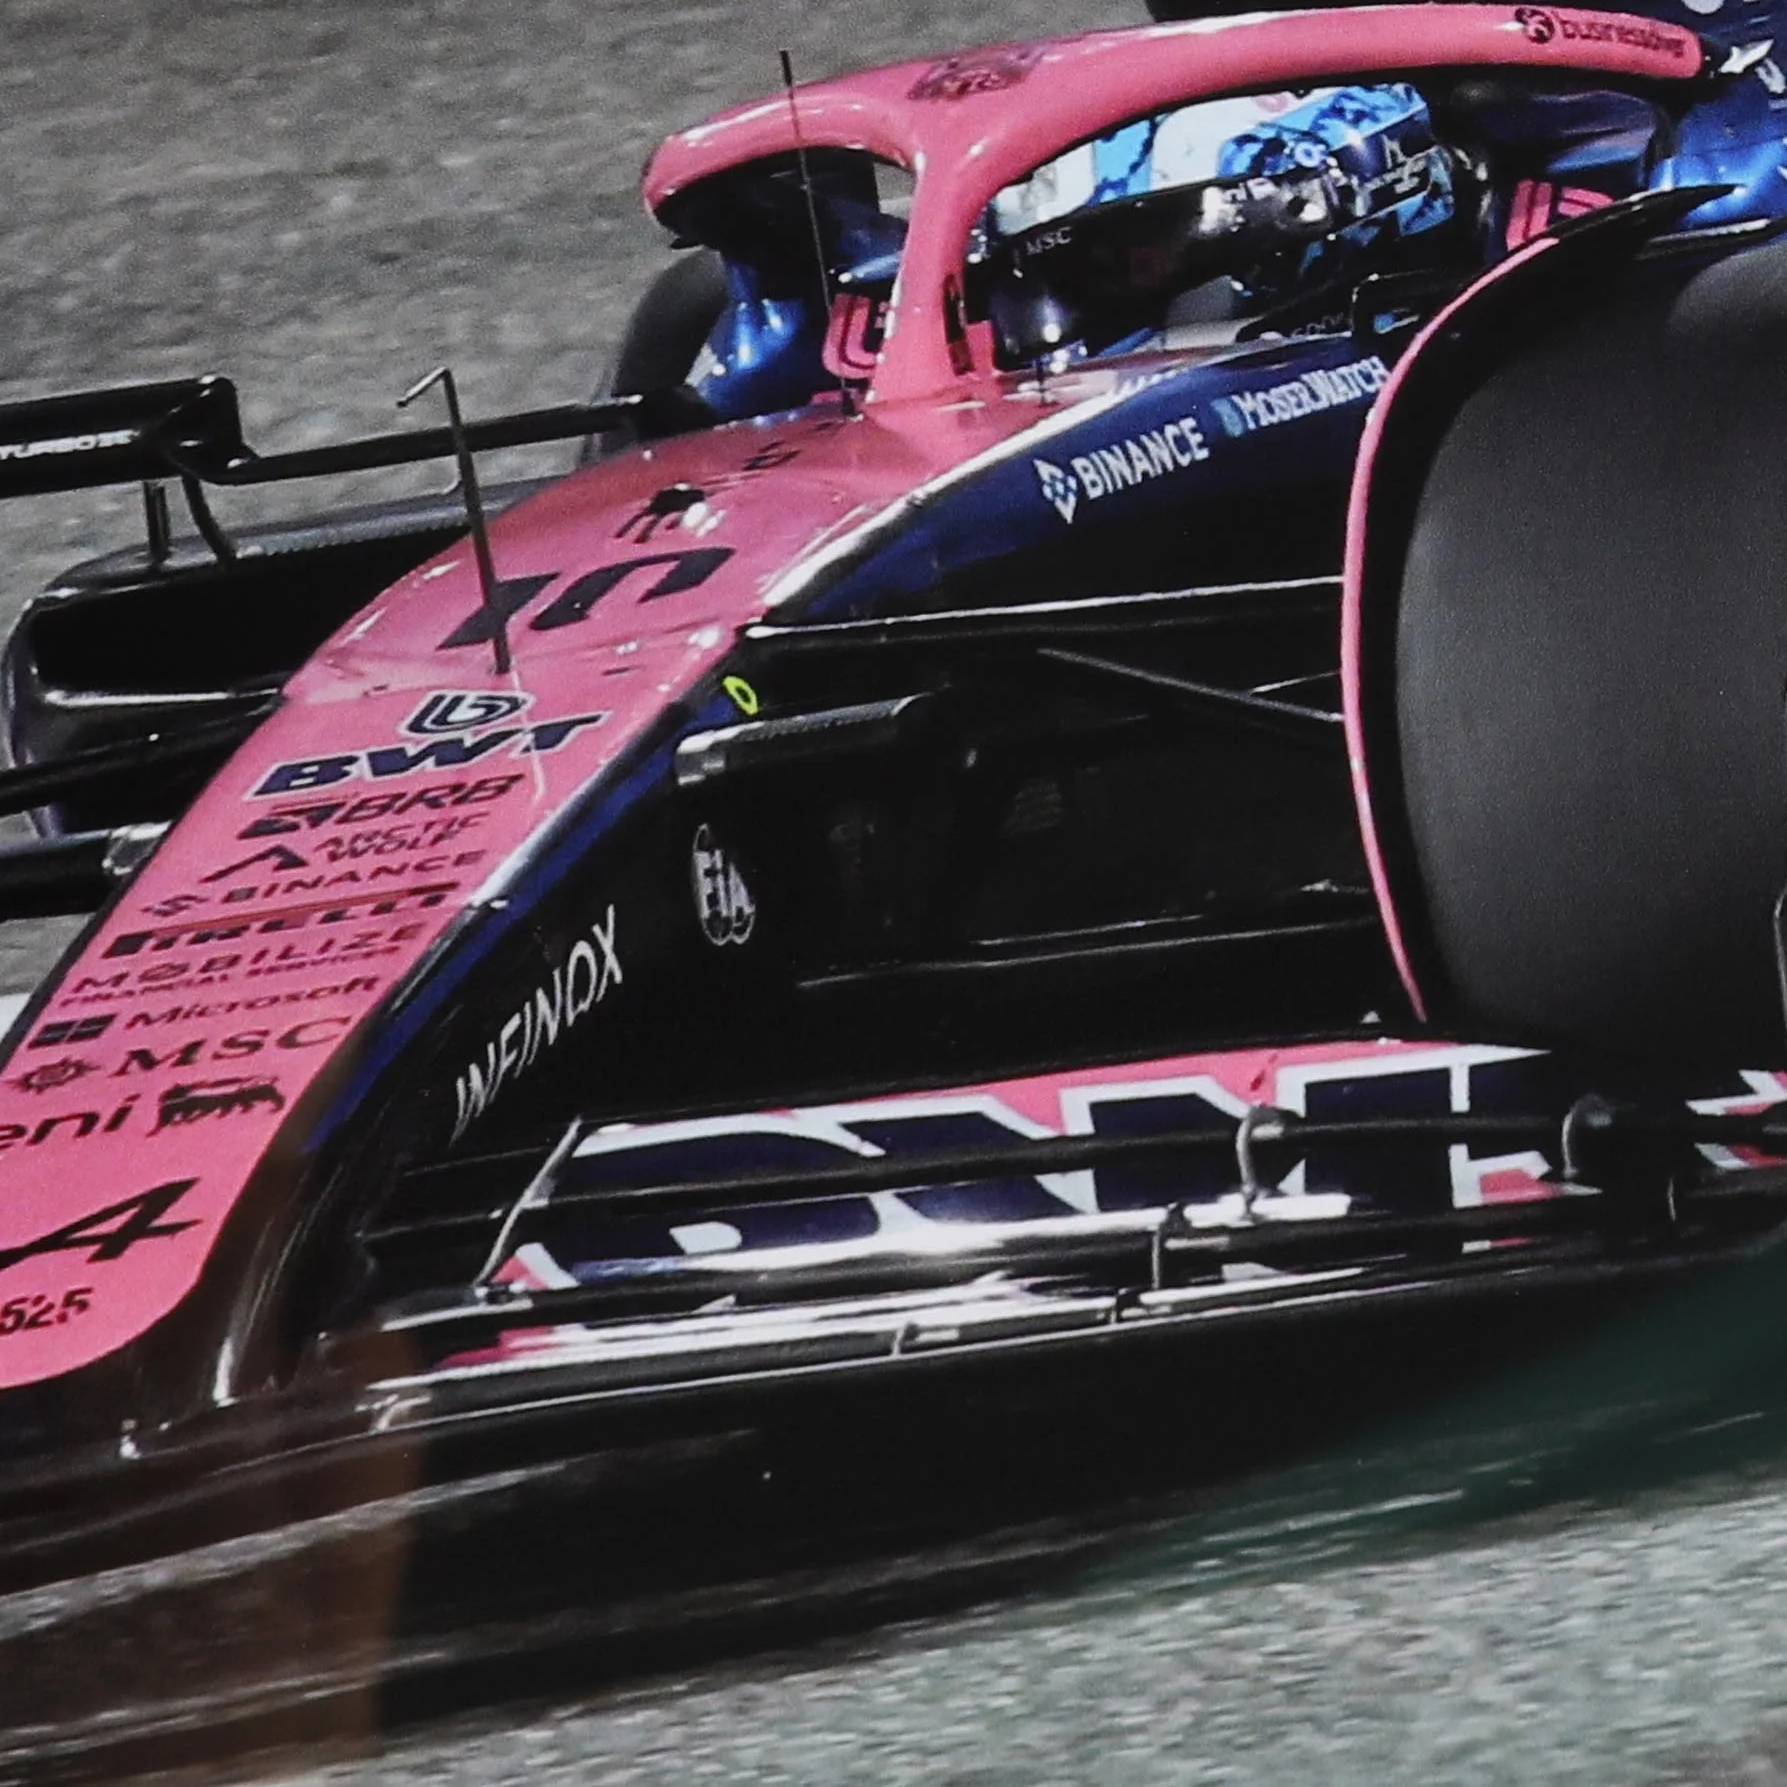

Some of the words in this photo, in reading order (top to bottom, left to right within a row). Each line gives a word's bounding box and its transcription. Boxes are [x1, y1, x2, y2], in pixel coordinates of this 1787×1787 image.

[1070, 416, 1210, 501] BINANCE
[243, 710, 612, 802] BWT
[220, 849, 488, 905] BINANCE
[70, 922, 427, 995] MOBILIZE
[125, 975, 382, 1030] Microsoft
[450, 903, 624, 1147] INFINOX
[109, 1015, 352, 1078] MSC
